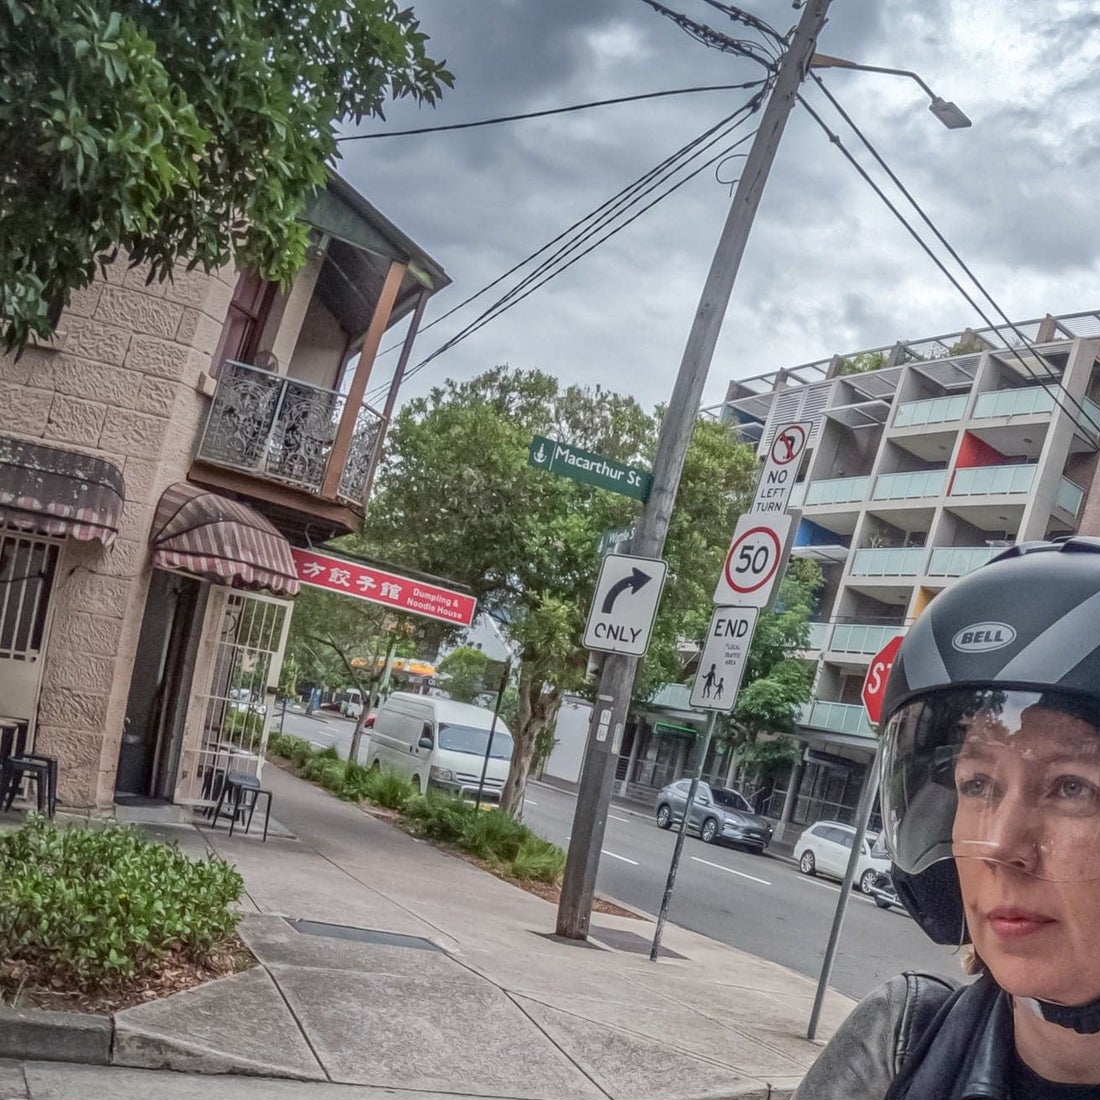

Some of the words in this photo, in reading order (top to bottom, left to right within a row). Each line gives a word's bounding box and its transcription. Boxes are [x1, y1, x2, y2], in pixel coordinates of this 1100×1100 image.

[555, 445, 625, 481] Macarthur
[626, 470, 642, 487] St
[767, 469, 788, 484] NO
[760, 487, 787, 499] LEFT
[757, 501, 783, 513] TURN
[735, 545, 769, 575] 50
[295, 560, 402, 601] 方餃子館
[413, 587, 452, 607] Dumpling
[452, 599, 459, 608] &
[406, 597, 437, 612] Noodle
[437, 605, 463, 620] House
[714, 619, 749, 638] END
[961, 629, 1004, 645] BELL
